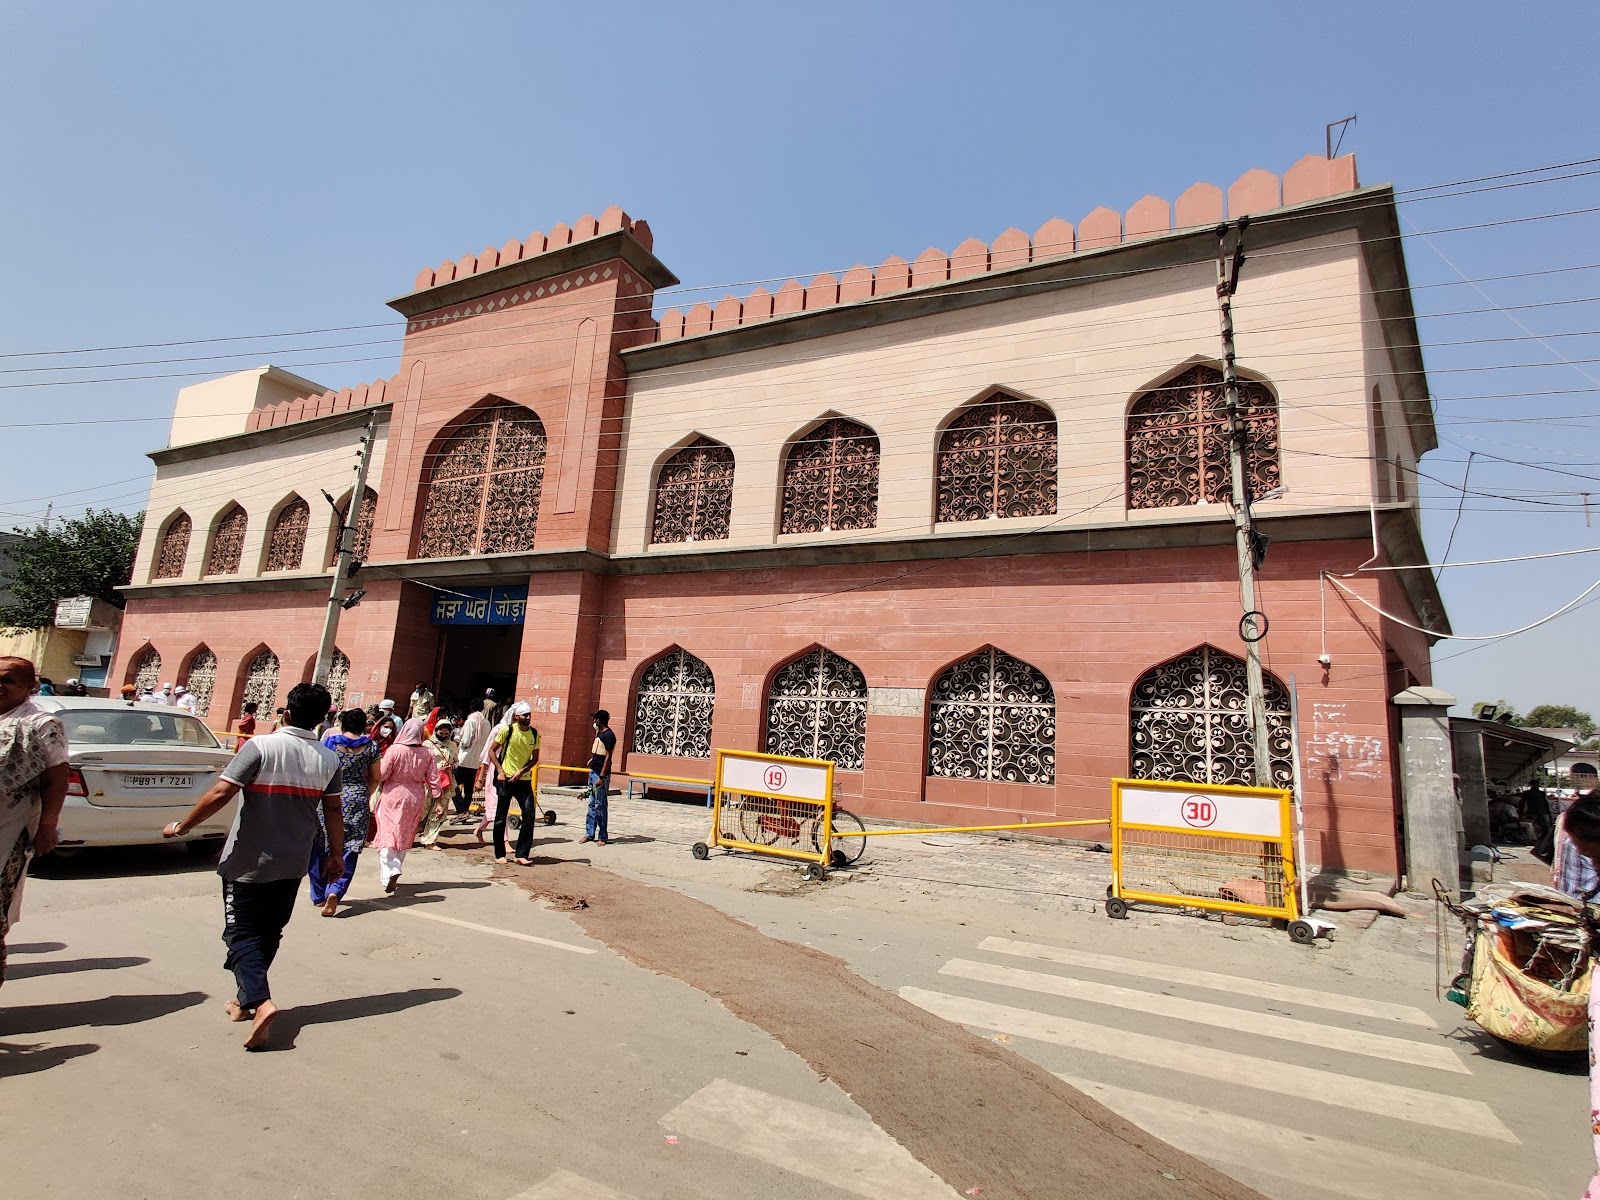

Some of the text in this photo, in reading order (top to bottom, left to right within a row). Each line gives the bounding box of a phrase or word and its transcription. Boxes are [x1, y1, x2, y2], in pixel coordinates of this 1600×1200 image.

[465, 600, 488, 619] ਘਰ
[495, 593, 527, 622] जोड़ा
[169, 776, 191, 786] 7241
[768, 771, 782, 786] 19
[1187, 802, 1211, 821] 30
